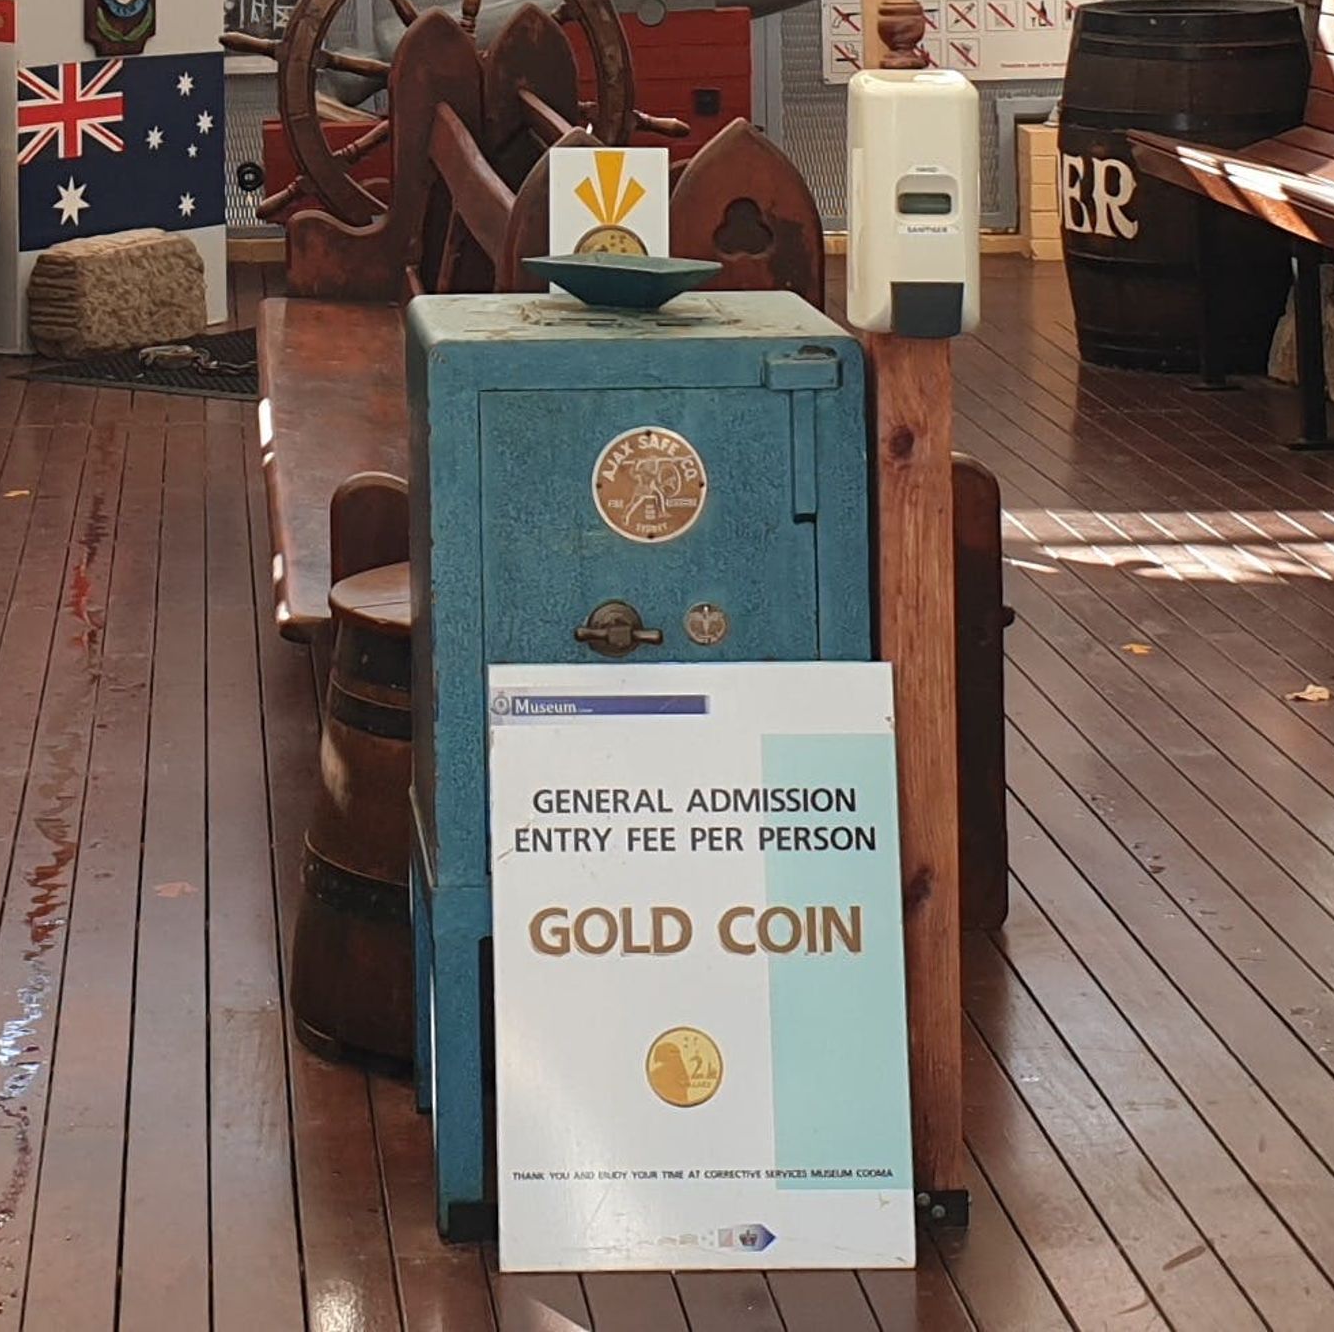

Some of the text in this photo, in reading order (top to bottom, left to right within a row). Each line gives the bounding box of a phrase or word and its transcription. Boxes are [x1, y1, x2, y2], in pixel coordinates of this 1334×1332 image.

[1062, 153, 1139, 240] ER
[637, 434, 681, 457] SAFE
[600, 441, 635, 483] AJAX
[514, 697, 577, 715] Museum
[532, 787, 857, 815] GENERAL ADMISSION
[514, 825, 877, 854] ENTRY FEE PER PERSON
[528, 905, 864, 958] GOLD COIN
[512, 1168, 894, 1181] THANK YOU AND ENJOY YOUR TIME AT CORRECTIVE SERVICES MUSEUM COOMA
